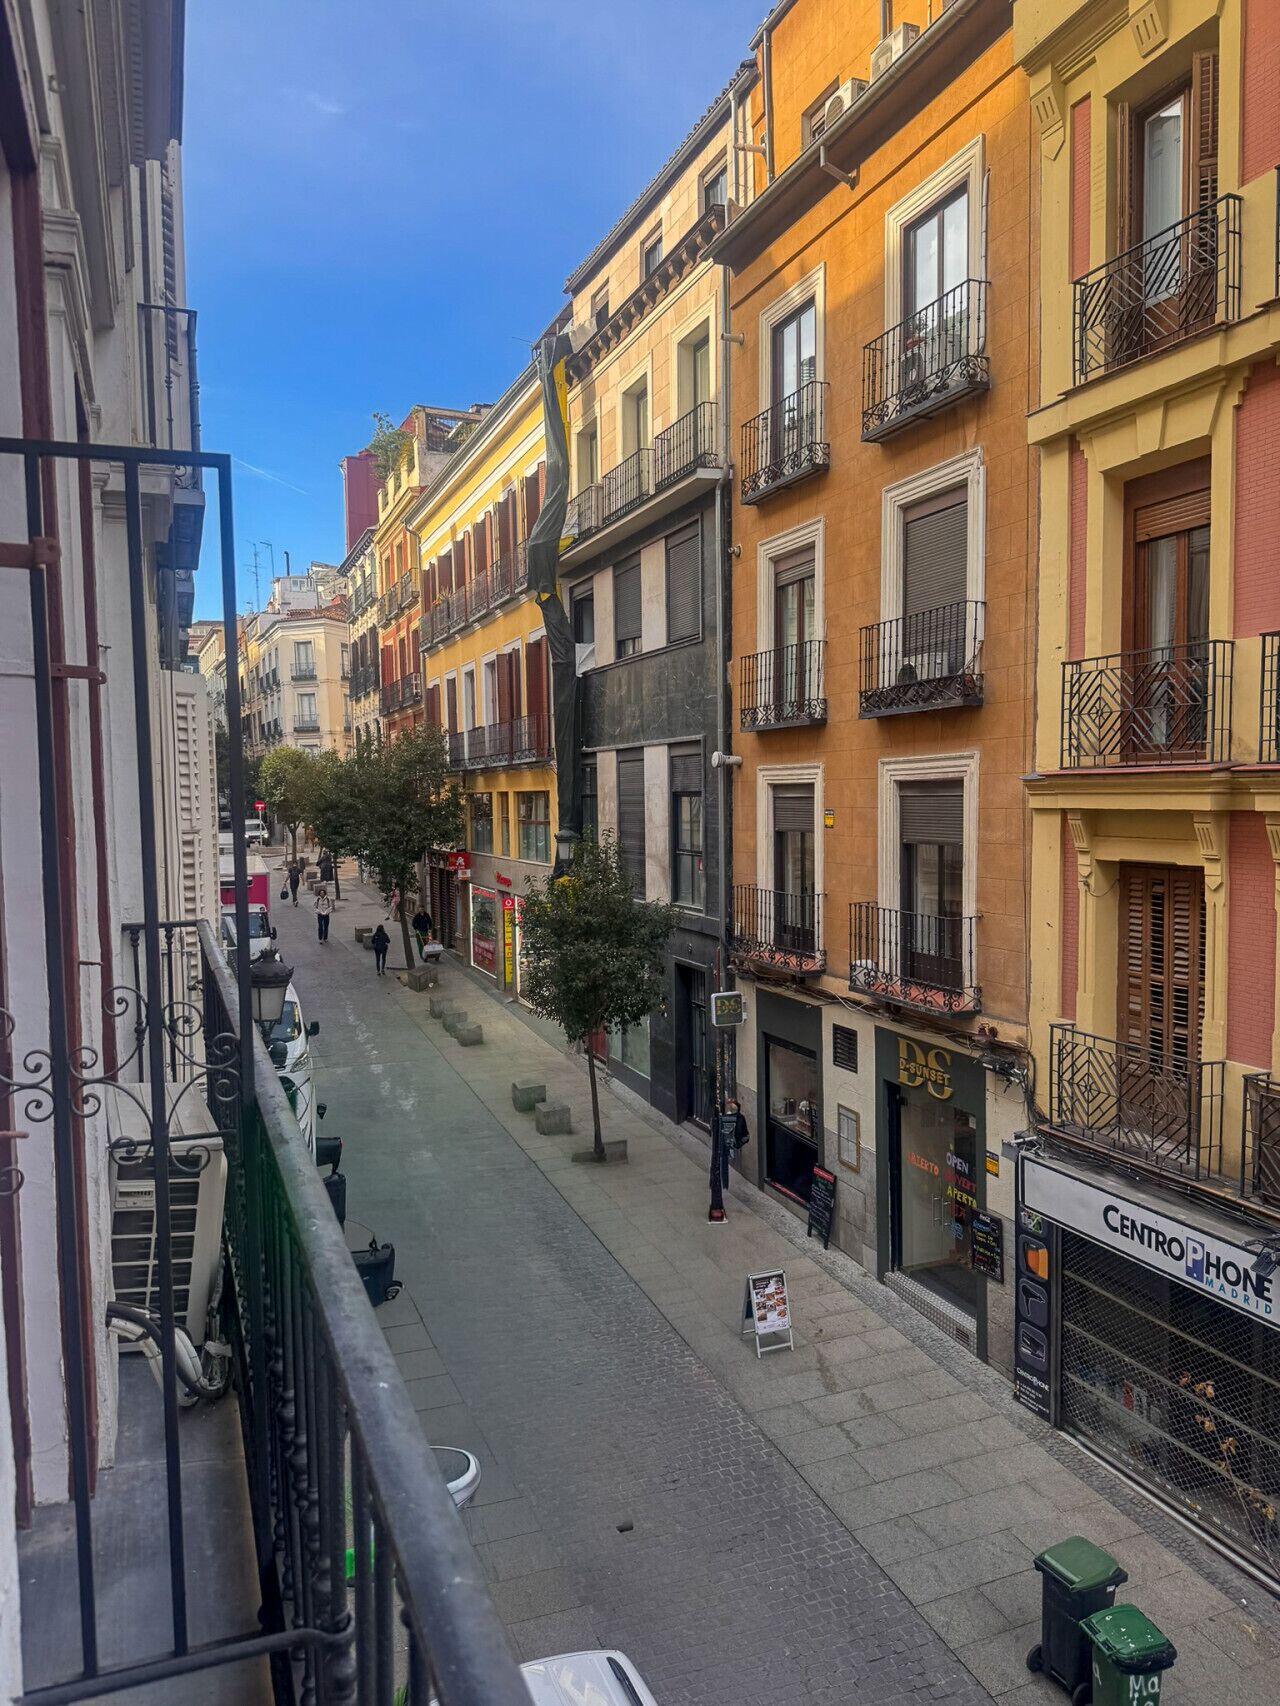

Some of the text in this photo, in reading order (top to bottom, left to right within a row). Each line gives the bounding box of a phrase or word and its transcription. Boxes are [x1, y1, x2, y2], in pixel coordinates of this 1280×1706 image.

[899, 1057, 951, 1086] D-SUNSET
[946, 1152, 969, 1174] OPEN
[1103, 1204, 1273, 1304] CENTROPHONE
[1205, 1276, 1272, 1314] MADRID
